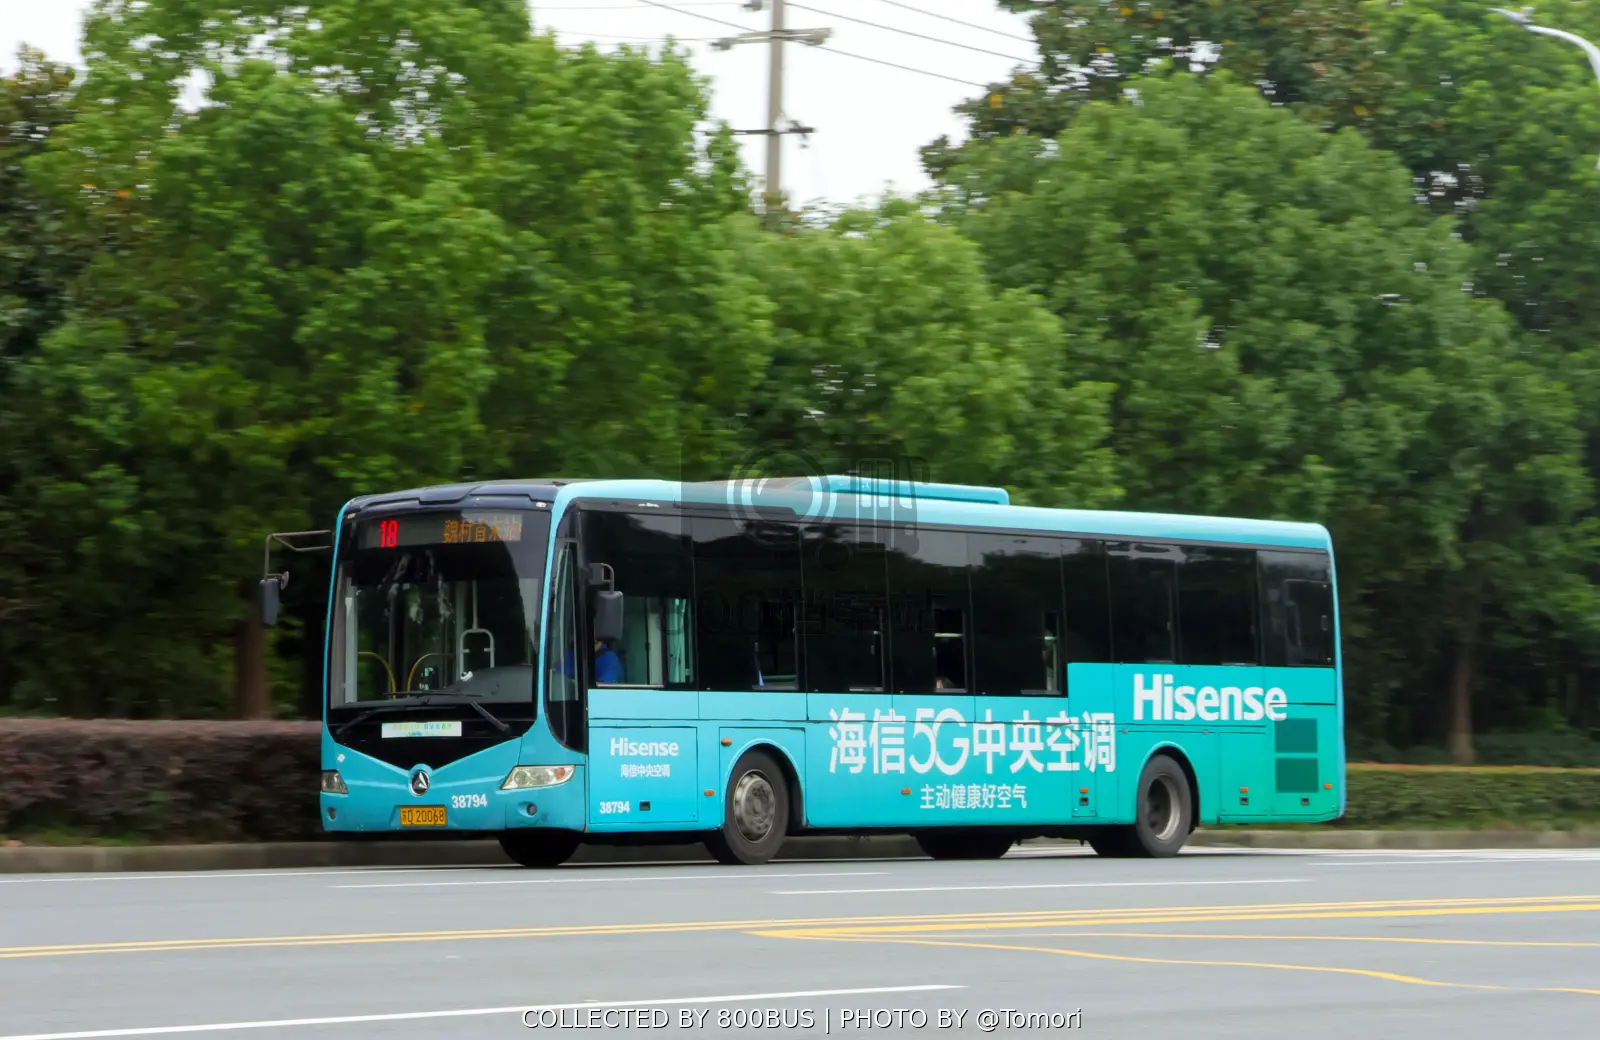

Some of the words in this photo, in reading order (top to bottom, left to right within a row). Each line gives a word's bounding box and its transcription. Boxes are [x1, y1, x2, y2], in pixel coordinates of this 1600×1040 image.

[379, 519, 400, 548] 18
[1133, 673, 1288, 721] Hisense
[609, 737, 679, 757] Hisense
[828, 707, 1116, 776] 海信5G中央空调
[620, 763, 671, 778] 海信中央空调
[451, 794, 488, 809] 38794
[599, 800, 630, 815] 38794
[919, 783, 1028, 810] 主动健康好空气
